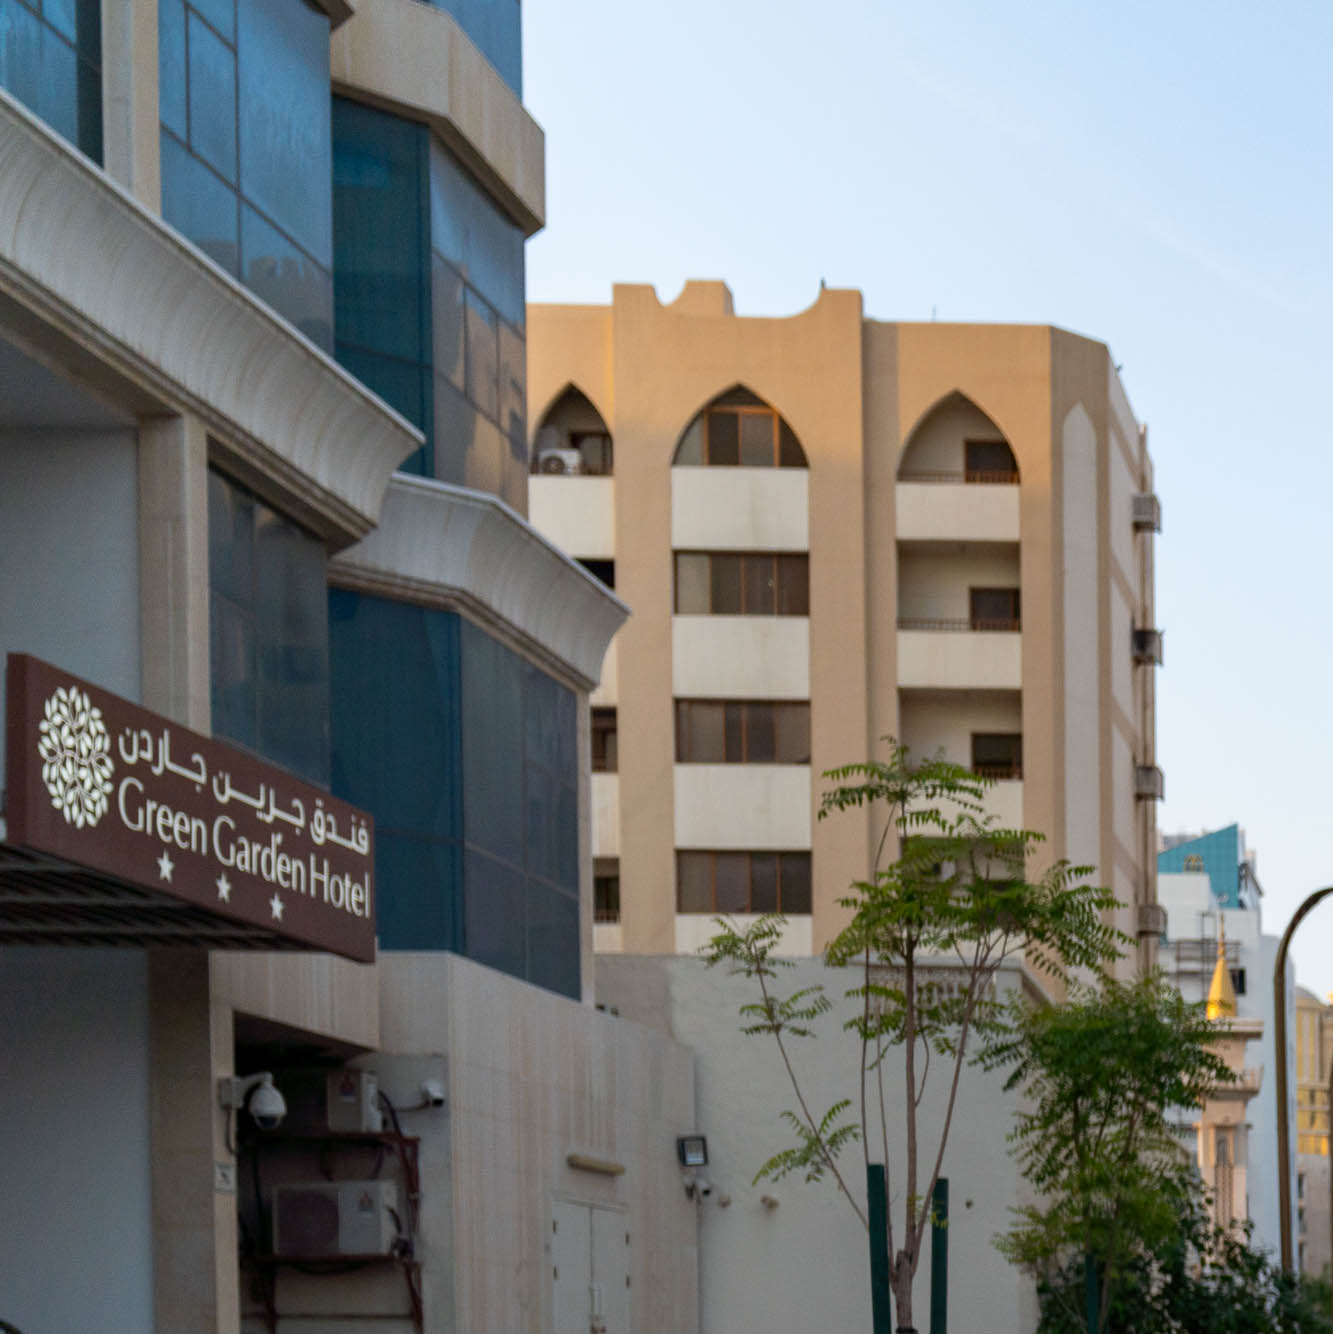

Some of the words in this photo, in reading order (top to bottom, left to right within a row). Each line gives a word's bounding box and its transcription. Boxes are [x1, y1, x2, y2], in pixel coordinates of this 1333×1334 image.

[118, 727, 208, 793] جاردن
[212, 770, 305, 836] جرين
[310, 798, 370, 856] فندق
[118, 776, 208, 856] Green
[213, 815, 306, 894] Garden
[310, 852, 371, 919] Hotel
